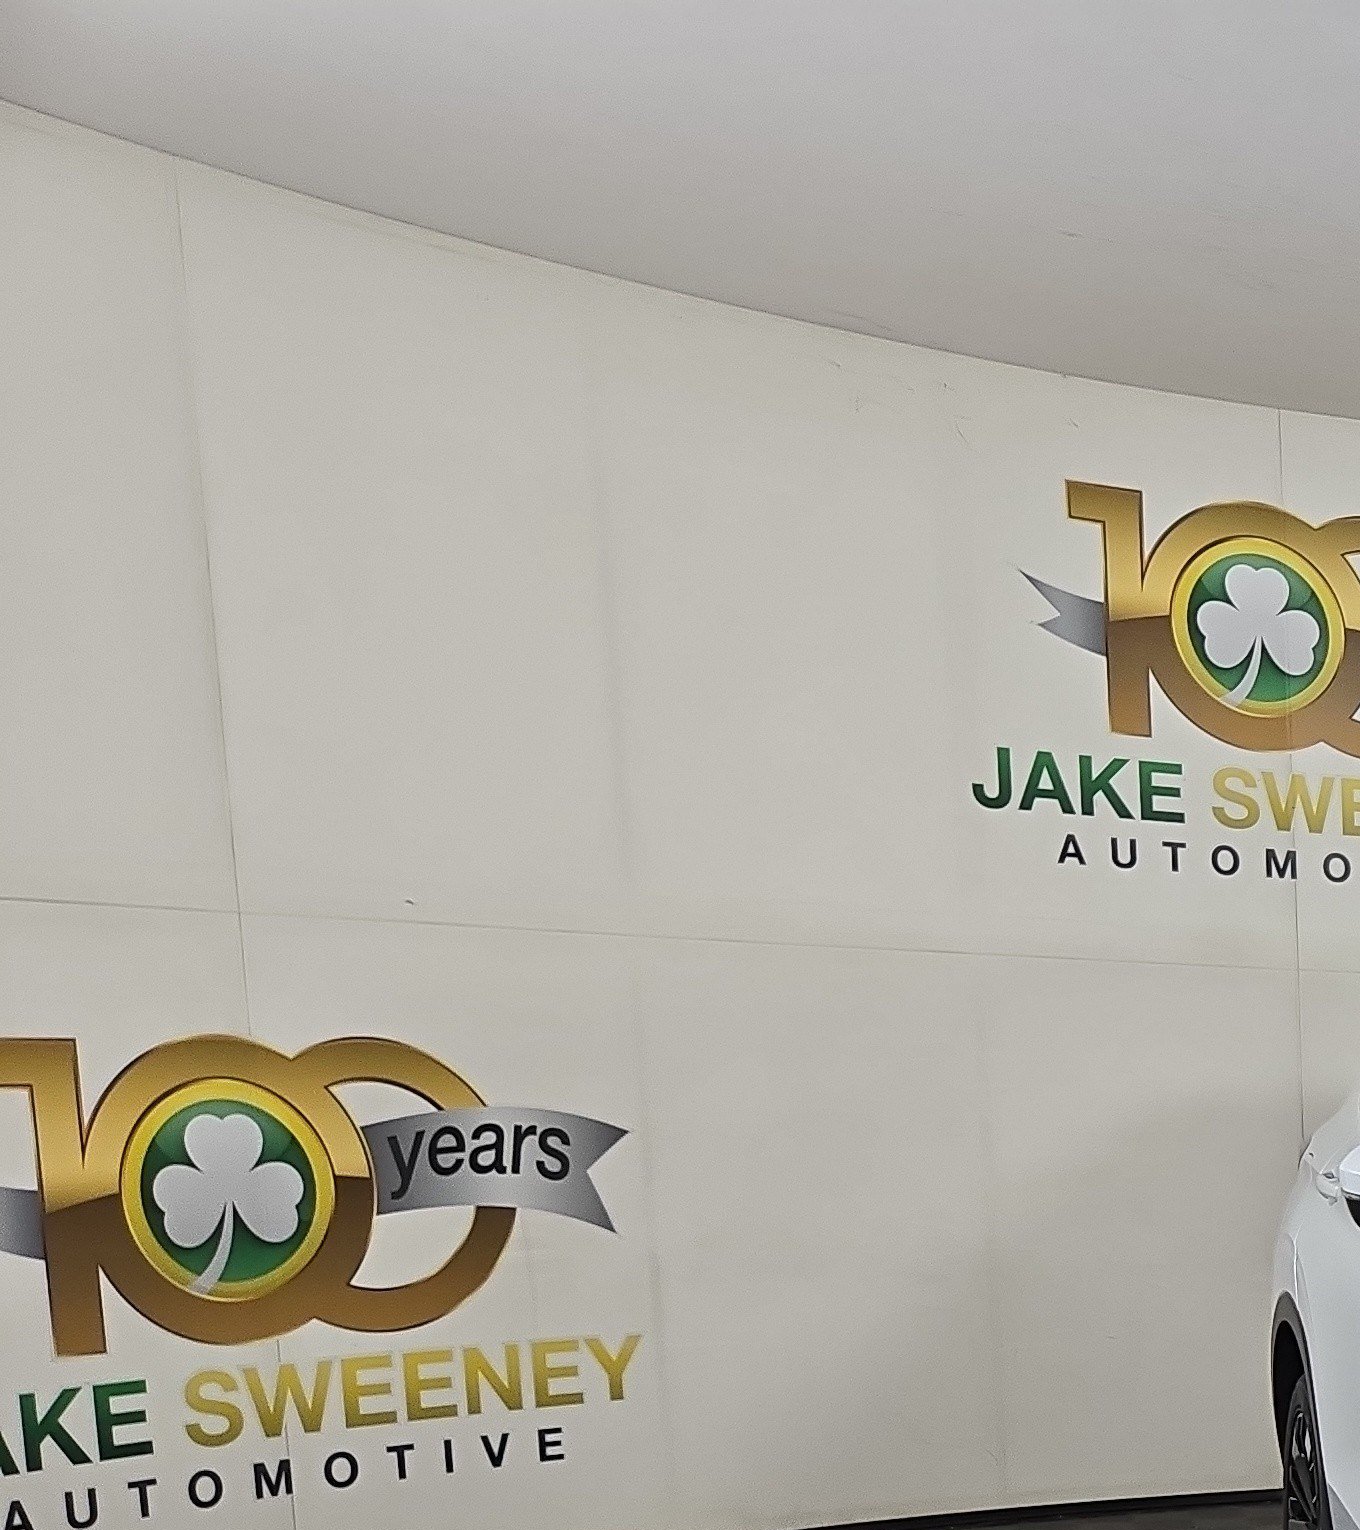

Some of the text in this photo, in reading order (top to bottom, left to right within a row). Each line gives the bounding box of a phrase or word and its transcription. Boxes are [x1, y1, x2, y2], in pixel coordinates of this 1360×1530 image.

[972, 747, 1186, 823] JAKE
[0, 1033, 571, 1358] 100 years
[0, 1334, 642, 1477] KE SWEENEY
